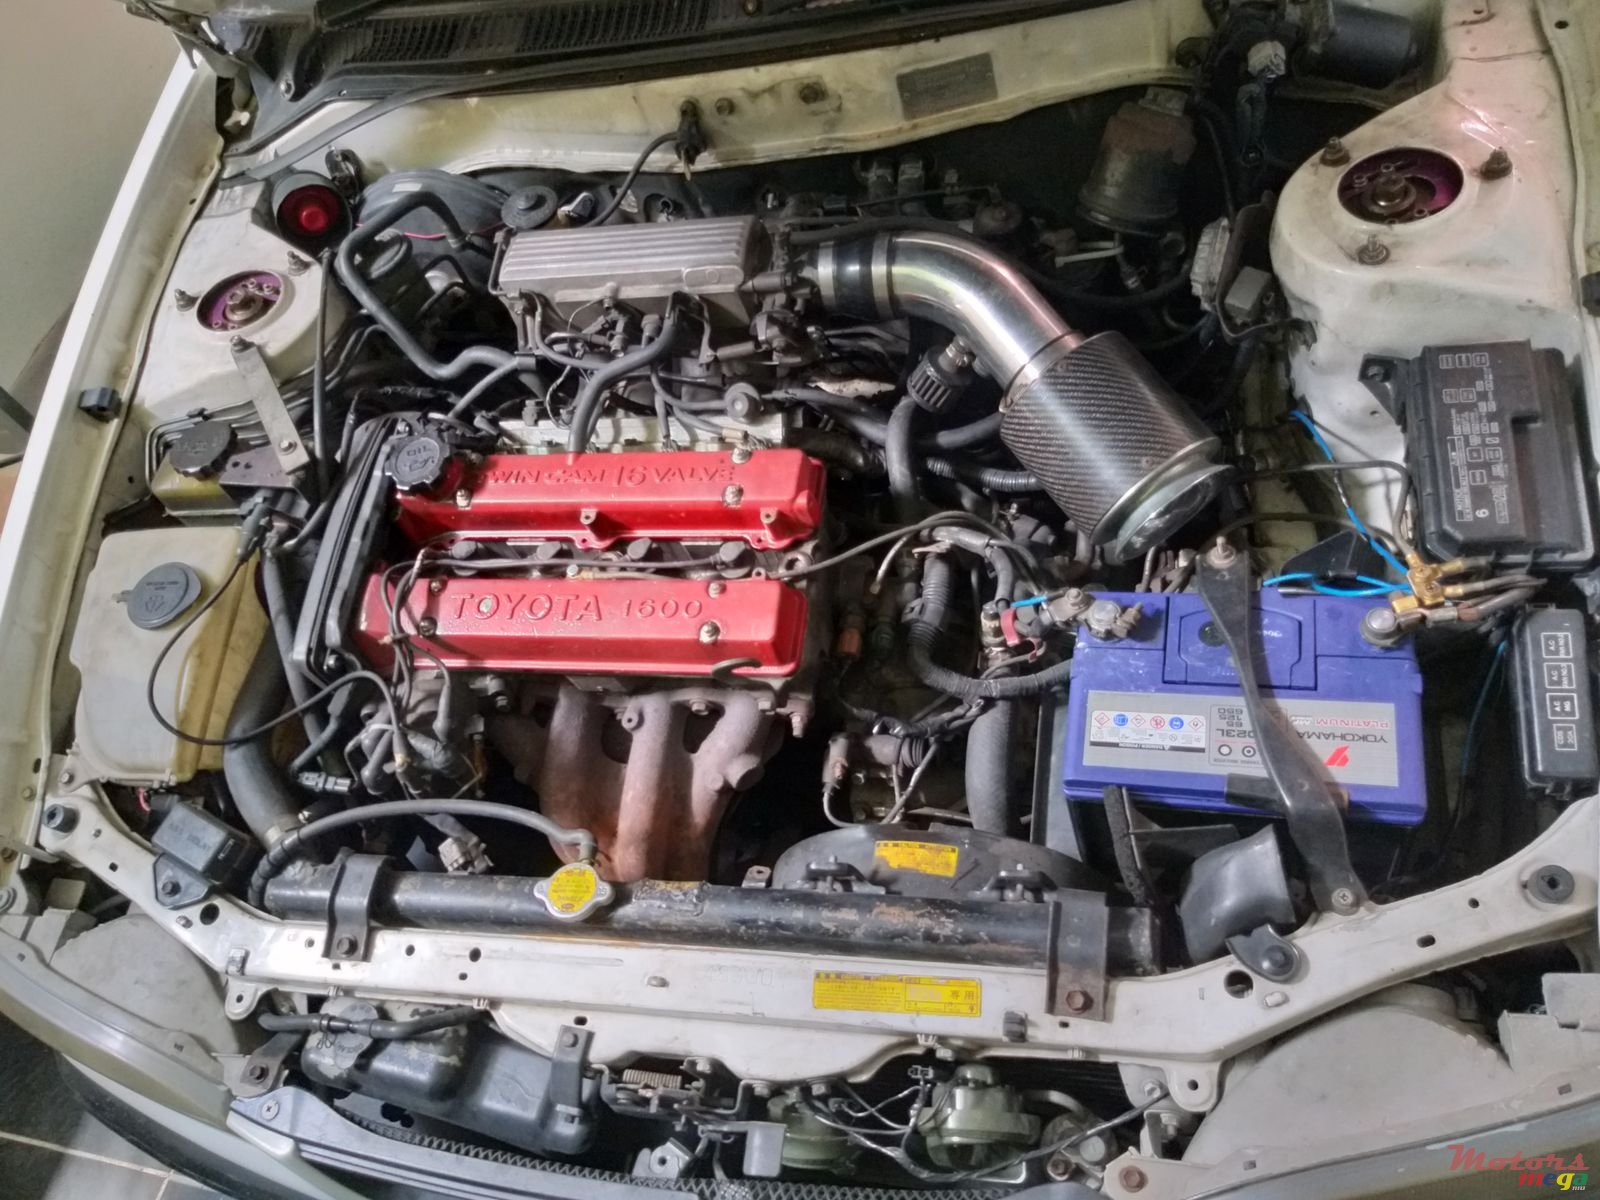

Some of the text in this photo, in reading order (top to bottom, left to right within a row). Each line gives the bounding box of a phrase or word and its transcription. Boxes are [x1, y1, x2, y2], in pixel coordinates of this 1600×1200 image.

[478, 465, 735, 486] WIN CAM 16 VALVE
[1475, 508, 1489, 518] 6
[451, 593, 704, 621] TOYOTA 1600
[1316, 718, 1389, 729] PLATINUM
[1296, 731, 1388, 743] YOKOHAMA
